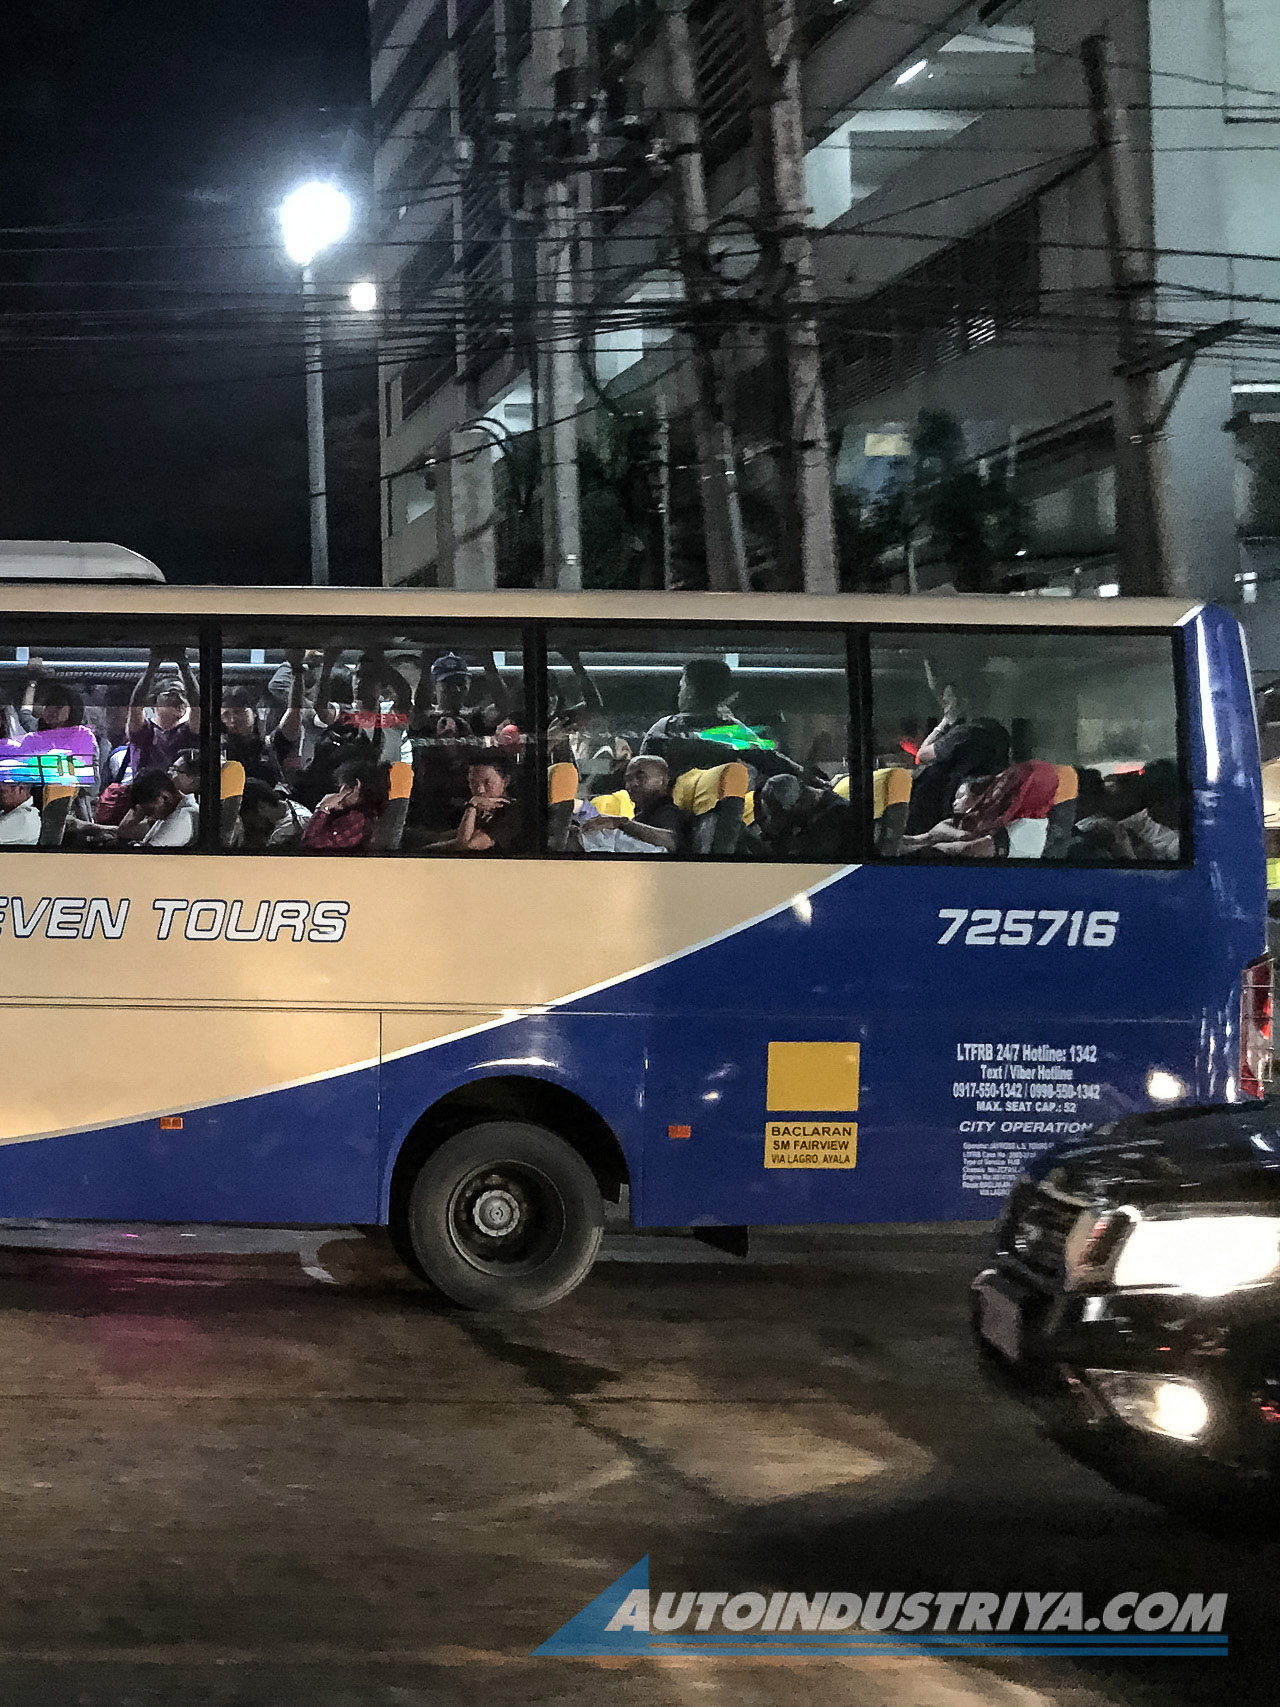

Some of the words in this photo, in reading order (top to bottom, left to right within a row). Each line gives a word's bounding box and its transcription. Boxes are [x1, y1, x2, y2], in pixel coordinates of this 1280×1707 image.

[152, 898, 350, 943] TOURS
[937, 908, 1119, 947] 725716
[956, 1043, 994, 1061] LTFRB
[996, 1043, 1020, 1062] 24/7
[1022, 1044, 1067, 1062] Hotline:
[1069, 1044, 1098, 1063] 1342
[980, 1064, 1003, 1080] Text
[1009, 1064, 1036, 1080] Viber
[1037, 1064, 1073, 1081] Hotline
[952, 1082, 1023, 1098] 0917-550-1342
[1005, 1101, 1033, 1112] SEAT
[1063, 1102, 1077, 1113] 52
[771, 1126, 852, 1137] BACLARAN
[959, 1120, 996, 1133] CITY
[1000, 1120, 1094, 1134] OPERATION
[772, 1140, 790, 1151] SM
[793, 1140, 850, 1151] FAIRVIEW
[771, 1154, 786, 1164] VIA
[822, 1154, 851, 1164] AYALA
